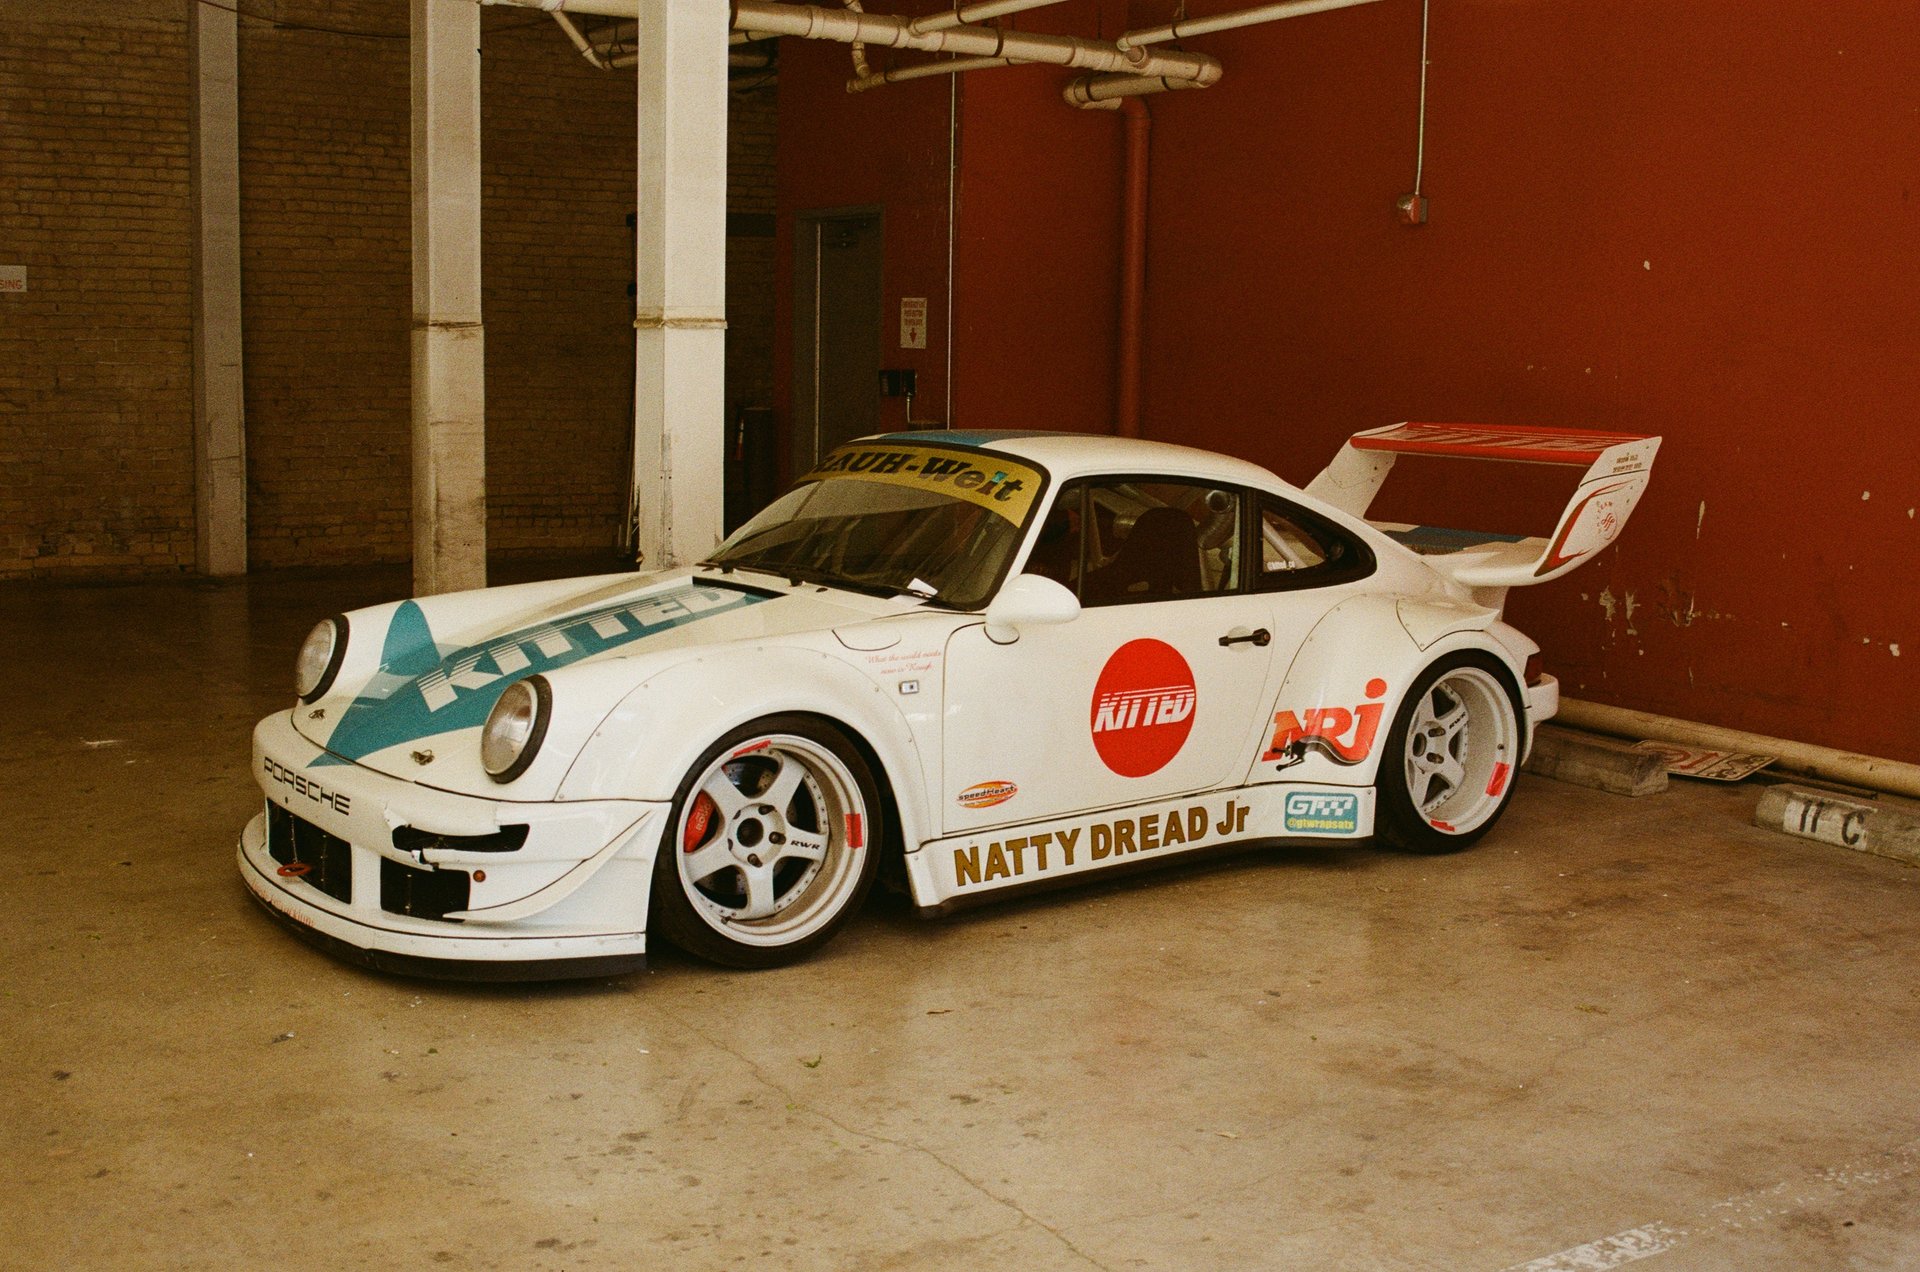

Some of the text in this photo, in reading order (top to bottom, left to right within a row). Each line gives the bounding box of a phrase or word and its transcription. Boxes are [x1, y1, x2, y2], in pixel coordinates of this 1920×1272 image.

[263, 756, 351, 816] PORSCHE
[790, 840, 821, 850] RWR
[954, 800, 1250, 887] NATTY DREAD Jr
[1841, 811, 1865, 846] C
